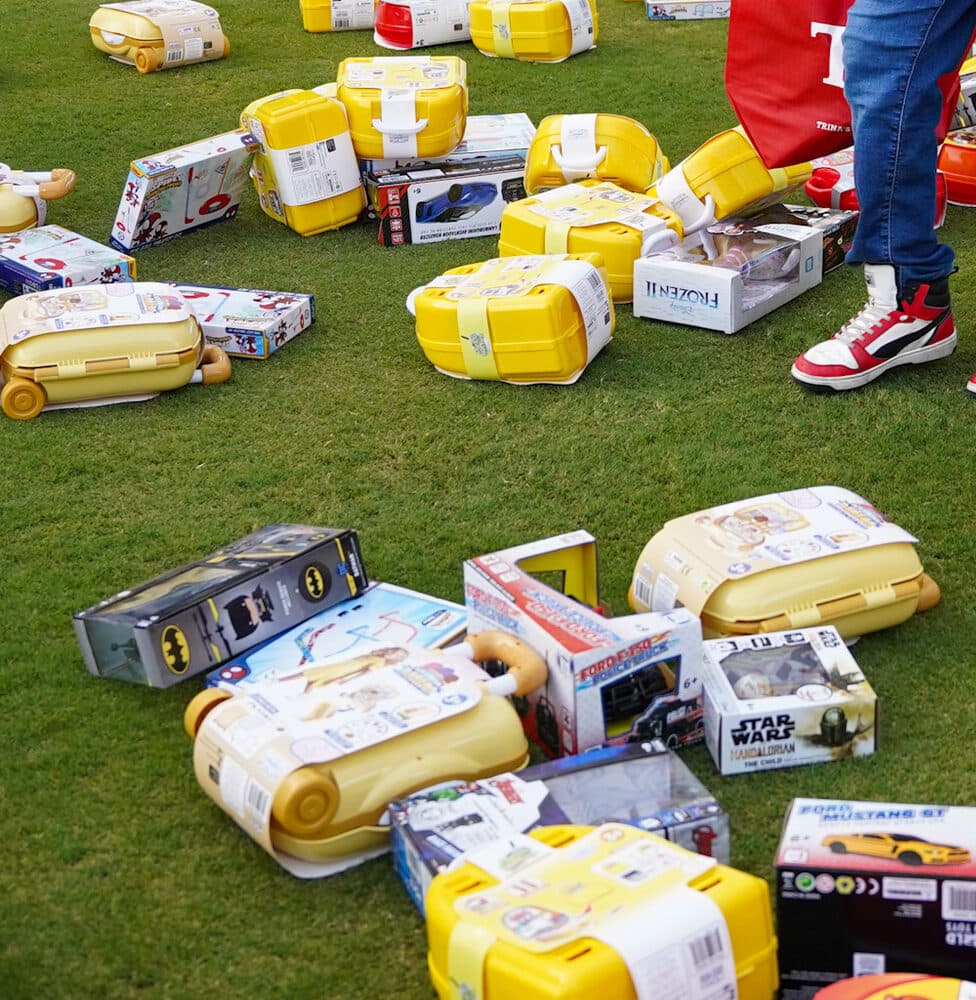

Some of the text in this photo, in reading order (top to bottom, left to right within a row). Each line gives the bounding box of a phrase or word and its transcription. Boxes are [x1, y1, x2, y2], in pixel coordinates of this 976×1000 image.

[810, 21, 847, 89] T
[646, 281, 719, 309] FROZEN II
[579, 638, 652, 682] FORD F-150
[592, 641, 670, 686] POLICE TRUCK
[683, 677, 698, 689] 6+
[731, 714, 795, 733] STAR
[731, 725, 796, 746] WARS
[730, 743, 796, 761] MANDALORIAN
[744, 758, 783, 768] THE CHILD
[800, 804, 851, 815] FORD
[822, 808, 946, 822] MUSTANG GT
[945, 921, 972, 932] TOYS
